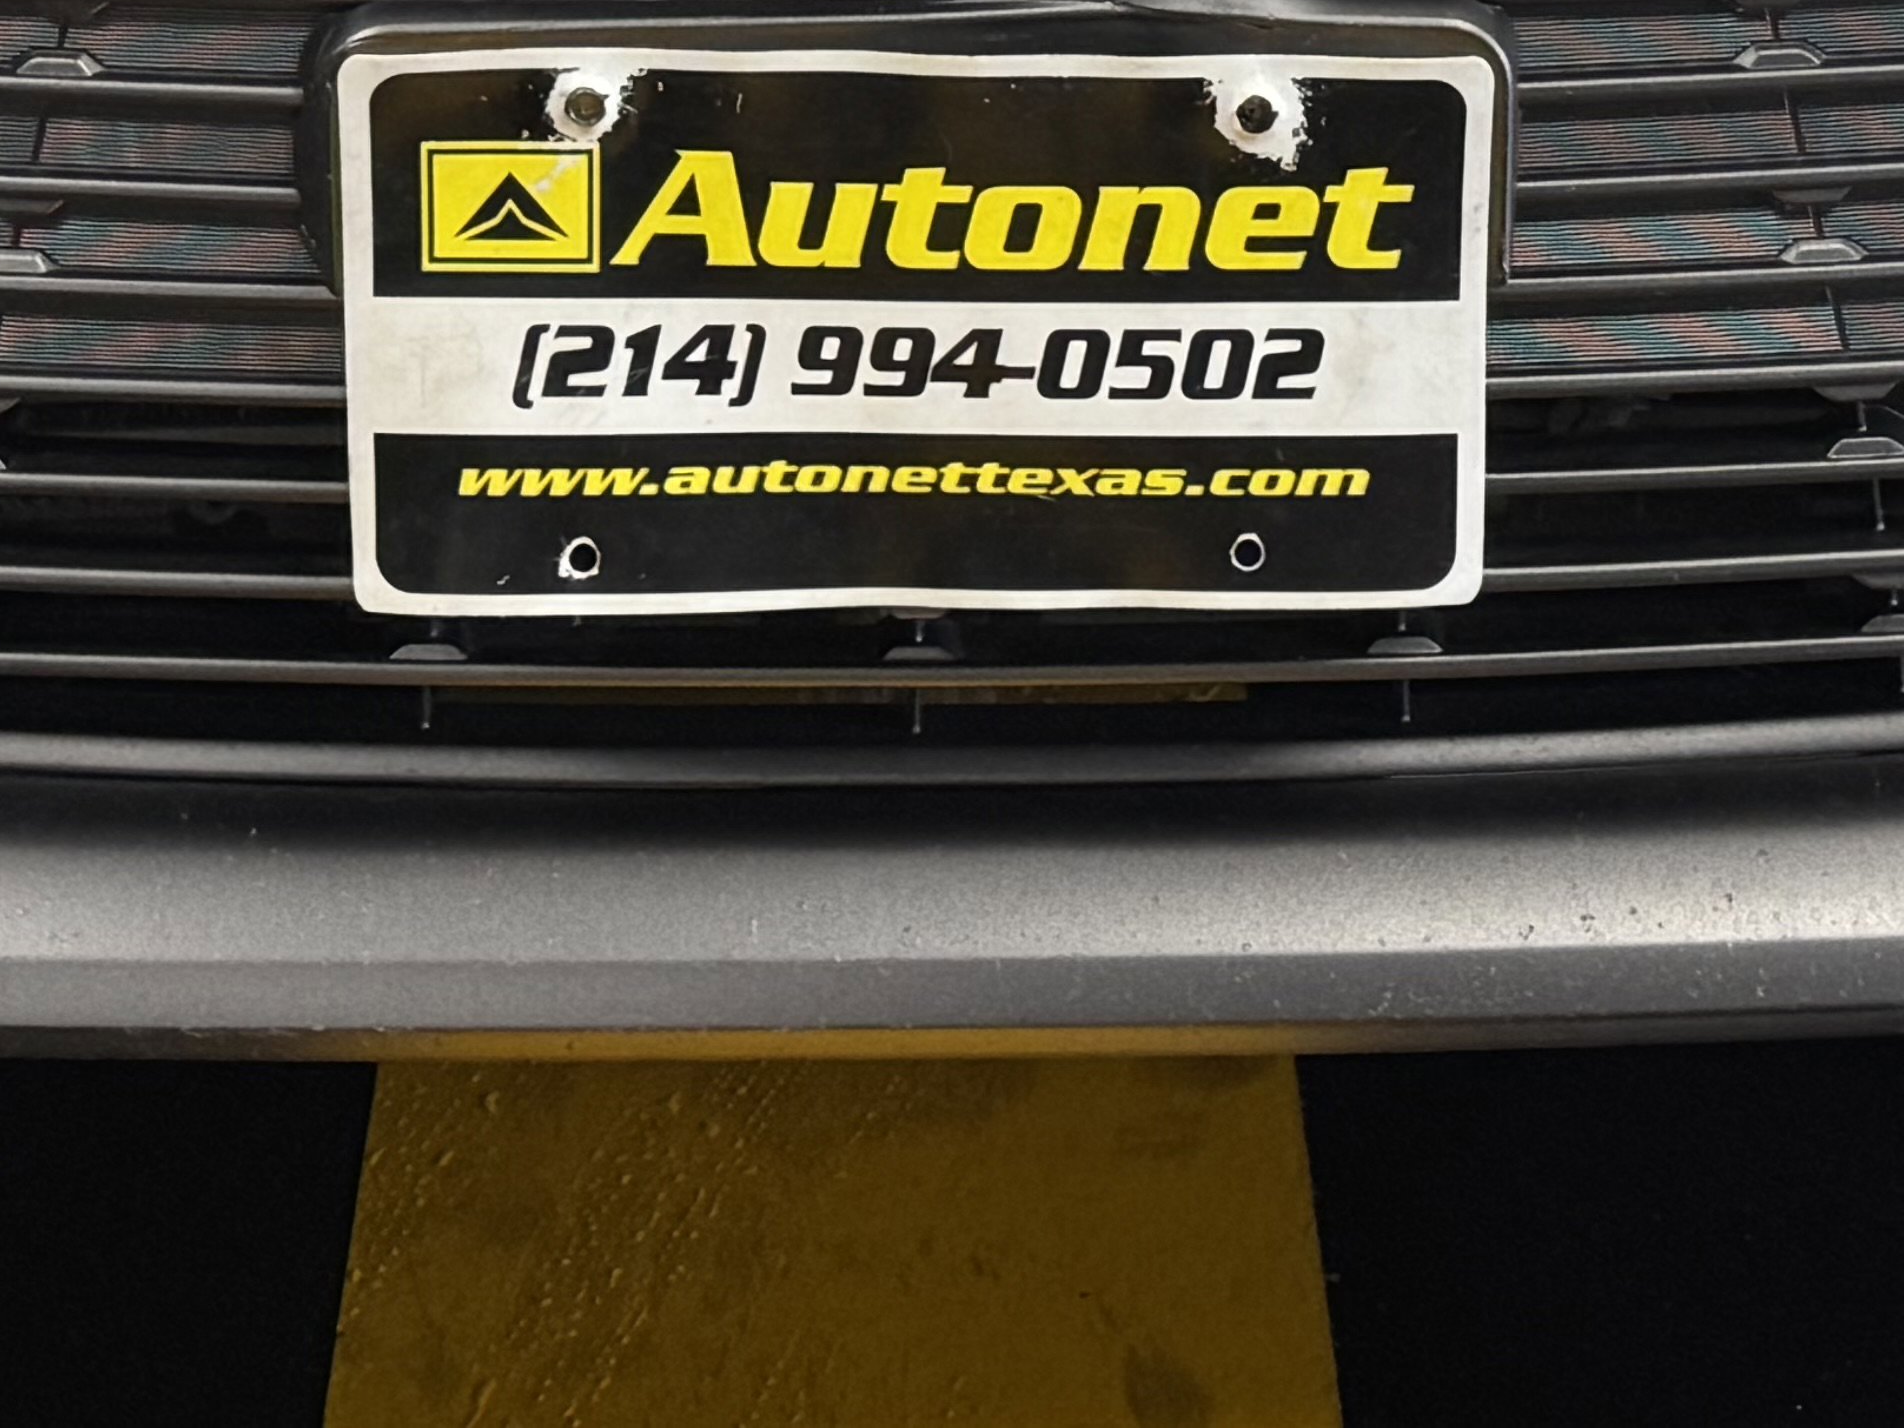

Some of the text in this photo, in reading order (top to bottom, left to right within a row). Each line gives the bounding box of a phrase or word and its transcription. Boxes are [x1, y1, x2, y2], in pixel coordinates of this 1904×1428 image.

[609, 150, 1414, 271] Autonet
[513, 324, 1325, 409] (214) 994-0502
[457, 460, 1371, 497] www.autonettexas.com
